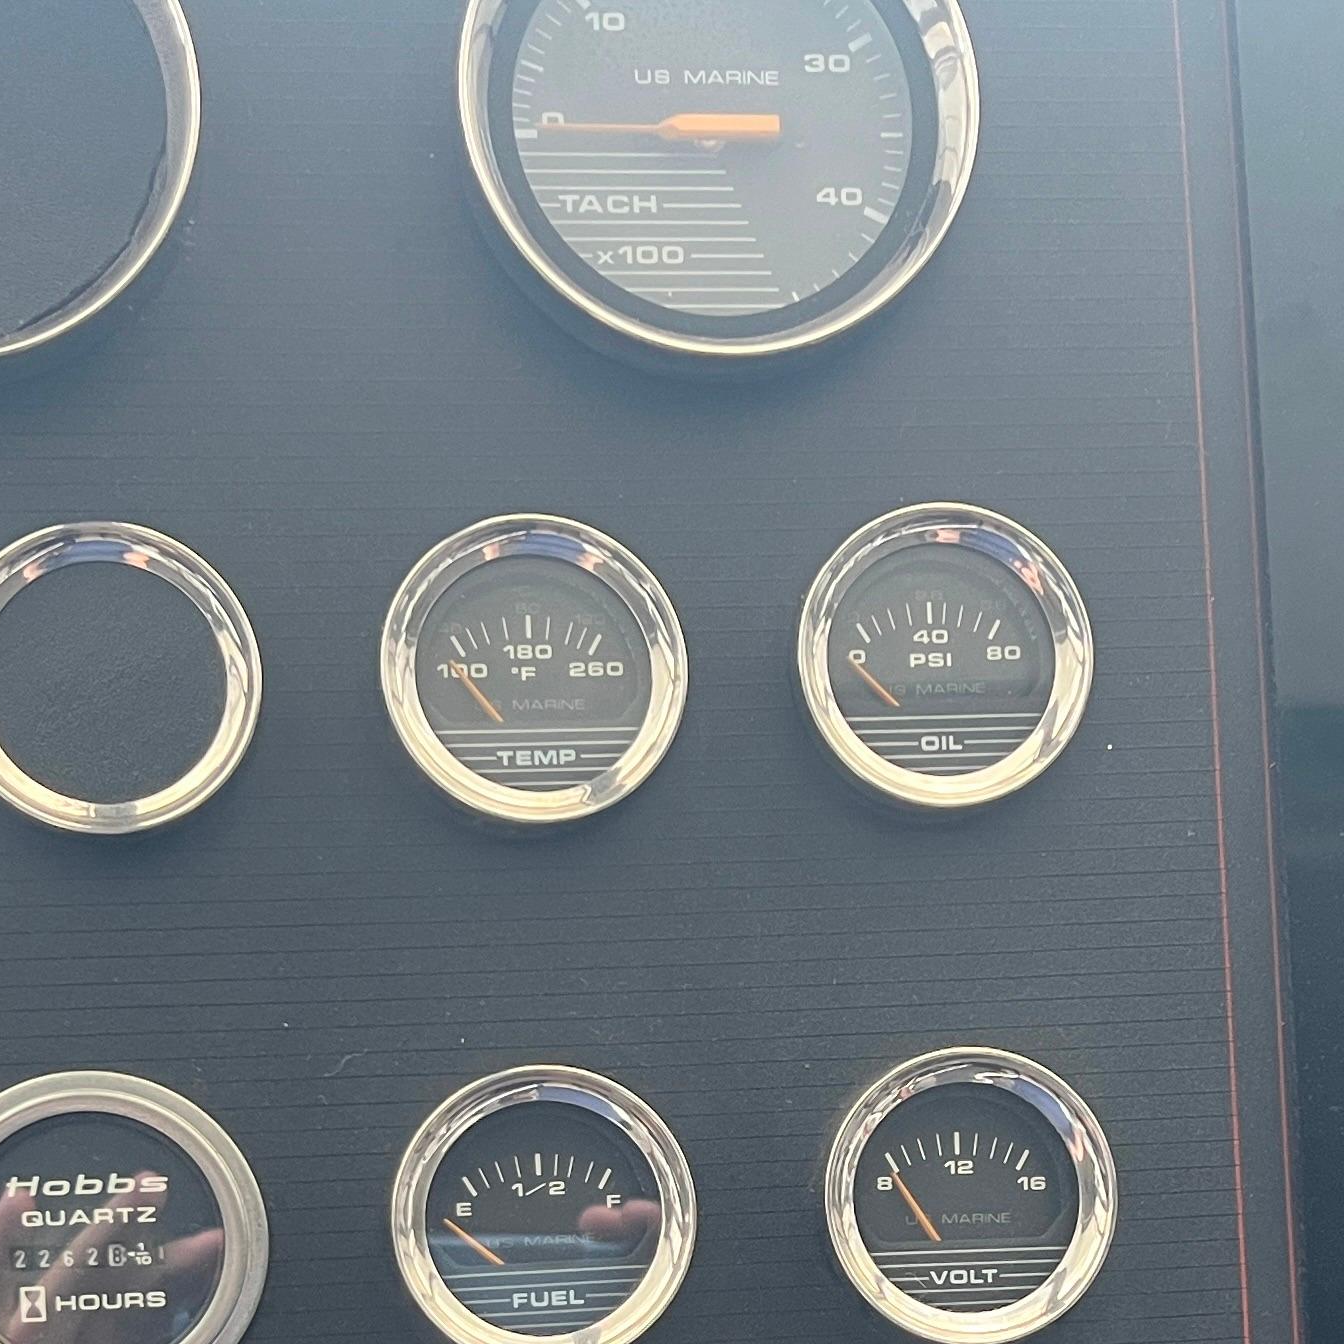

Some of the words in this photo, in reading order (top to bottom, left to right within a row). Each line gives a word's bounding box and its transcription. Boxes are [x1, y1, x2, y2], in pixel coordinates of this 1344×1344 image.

[586, 12, 625, 32] 10
[803, 54, 851, 73] 30
[634, 69, 670, 85] US
[684, 68, 780, 87] MARINE
[558, 194, 657, 214] TACH
[816, 187, 863, 207] 40
[596, 246, 684, 265] x100
[913, 629, 948, 645] 40
[503, 645, 553, 659] 180
[848, 649, 866, 664] 0
[986, 645, 1021, 661] 80
[909, 653, 952, 668] PSI
[436, 663, 488, 679] 100
[569, 662, 624, 677] 260
[916, 682, 986, 694] MARINE
[512, 699, 585, 711] MARINE
[921, 736, 963, 751] OIL
[497, 750, 577, 766] TEMP
[944, 1160, 974, 1175] 12
[7, 1173, 168, 1198] Hobbs
[512, 1181, 566, 1197] 1/2
[876, 1177, 893, 1191] 8
[1017, 1176, 1046, 1191] 16
[606, 1194, 621, 1208] F
[21, 1206, 157, 1227] QUARTZ
[456, 1202, 472, 1217] E
[941, 1212, 1012, 1225] MARINE
[929, 1269, 998, 1284] VOLT
[55, 1291, 167, 1312] HOURS
[512, 1289, 585, 1309] FUEL
